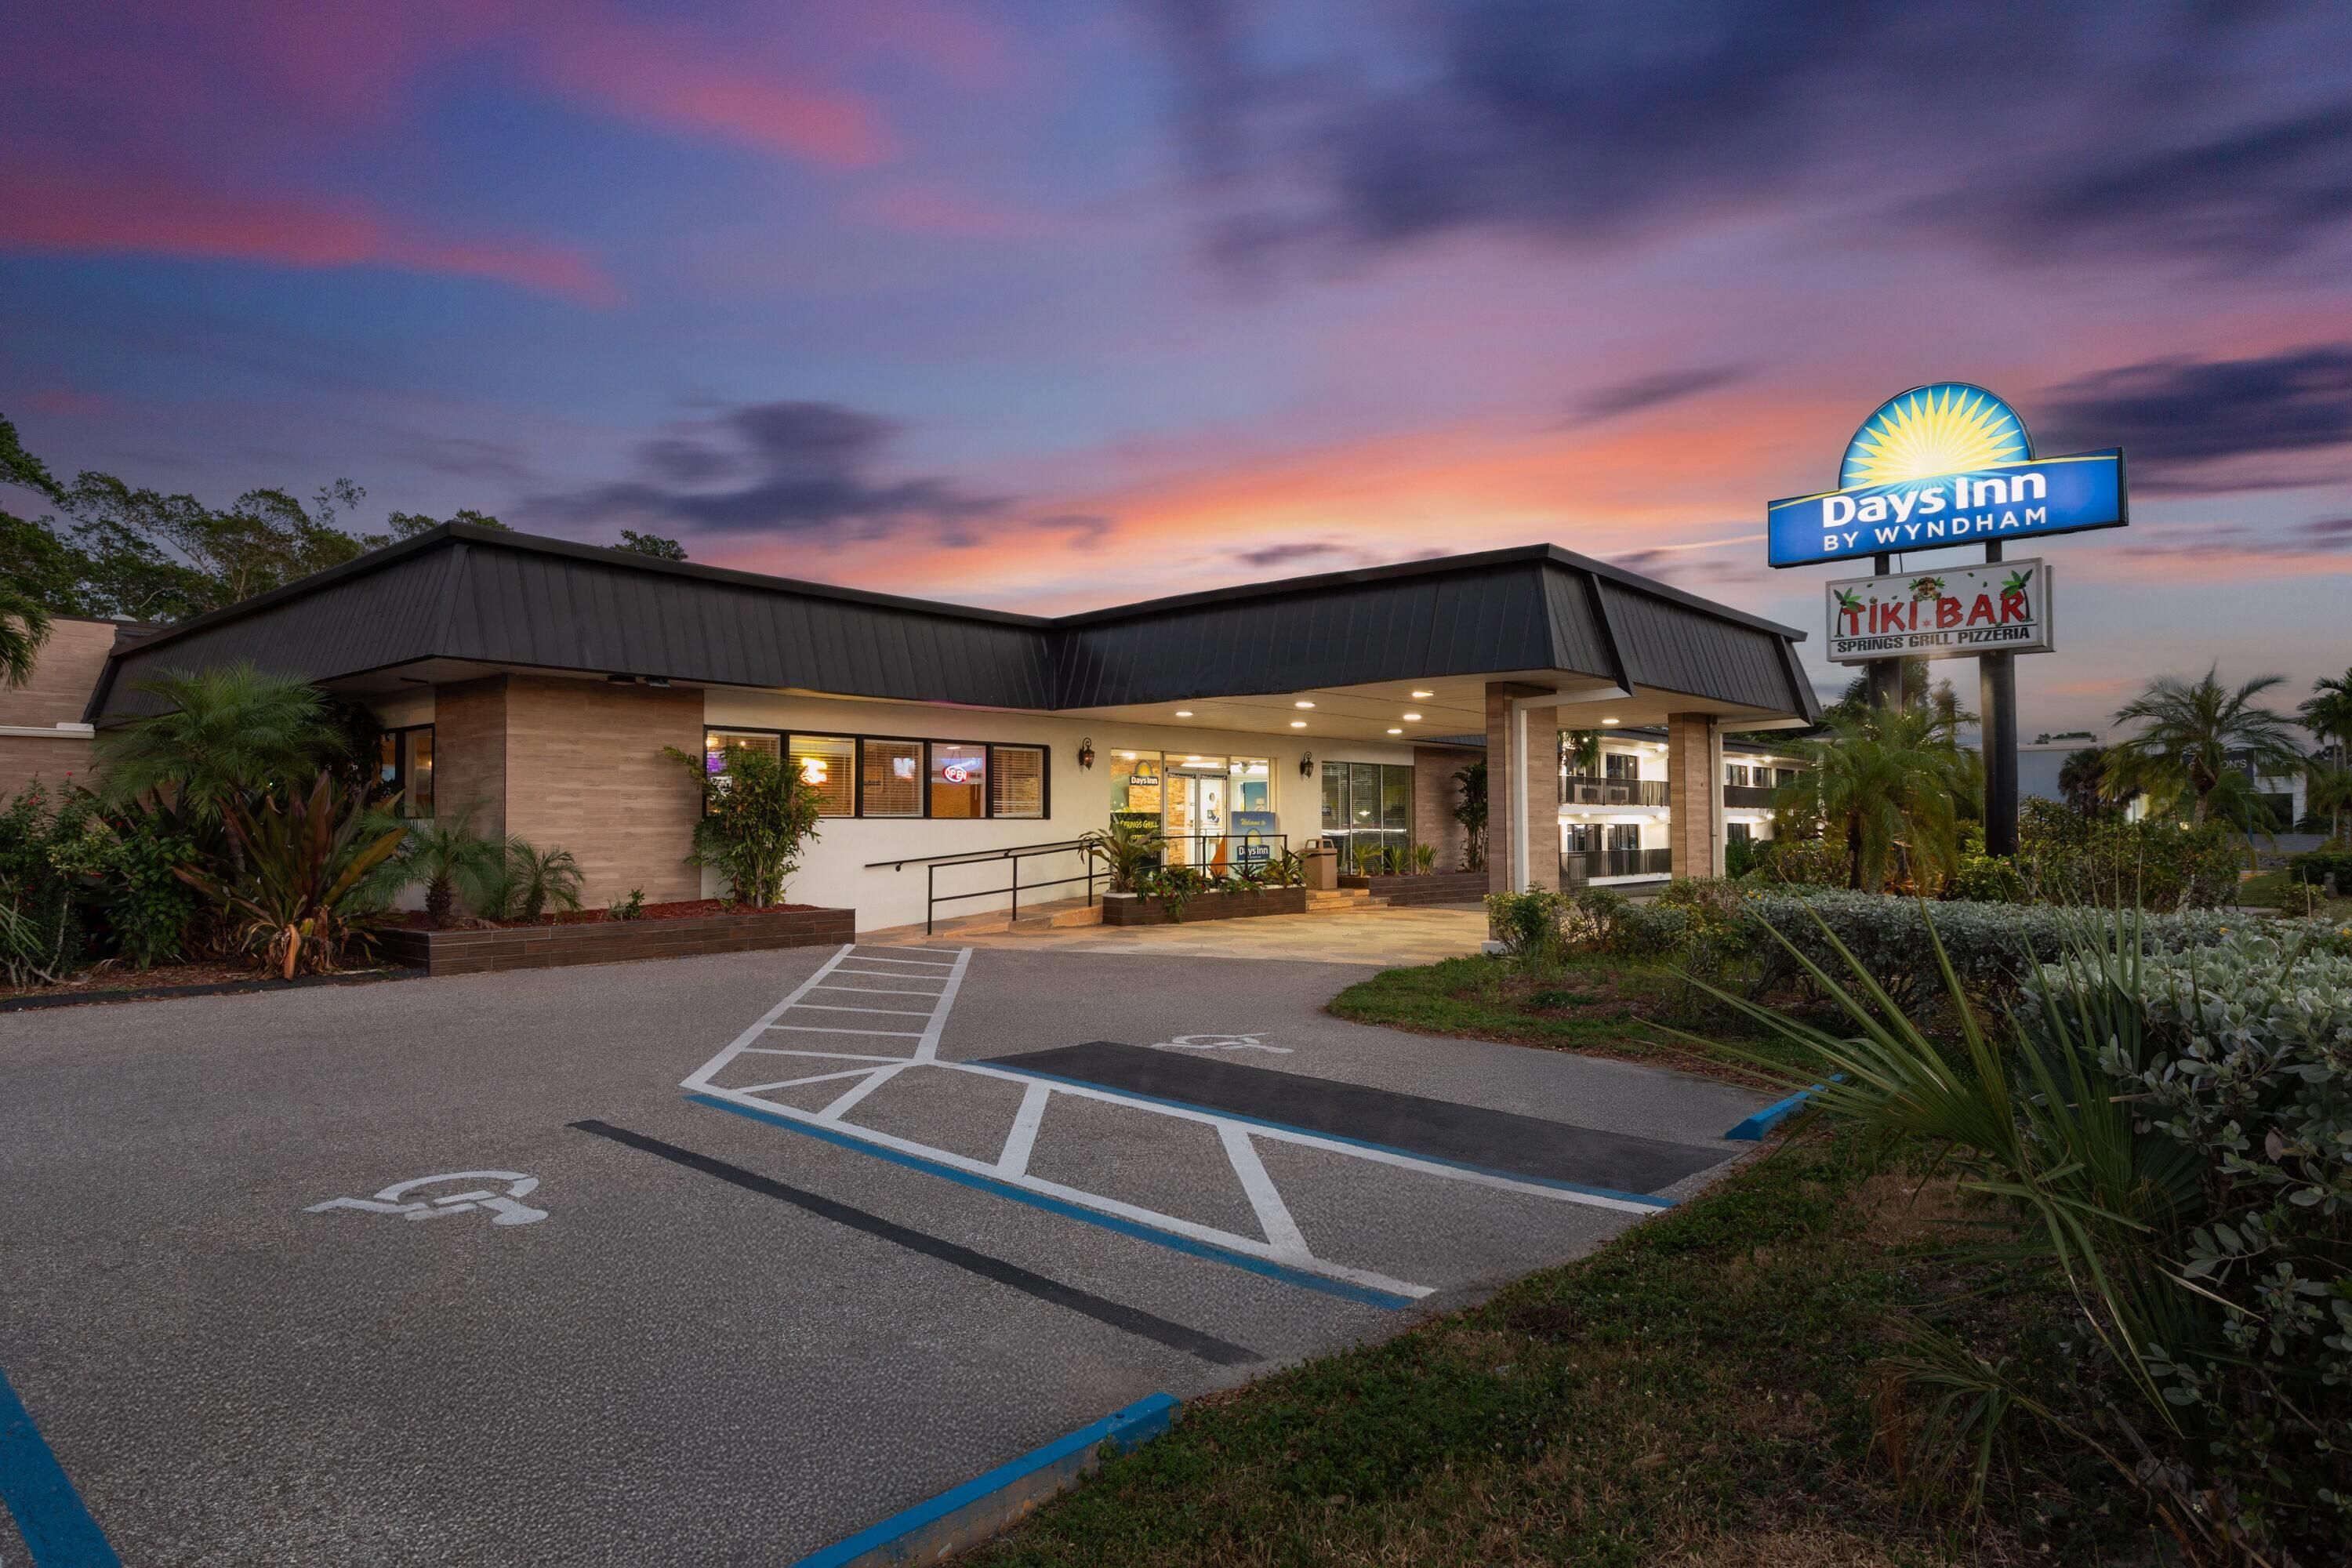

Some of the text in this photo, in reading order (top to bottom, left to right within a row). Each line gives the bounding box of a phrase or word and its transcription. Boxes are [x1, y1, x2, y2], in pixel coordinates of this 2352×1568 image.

[1823, 473, 2046, 528] Days Inn
[1824, 506, 2046, 551] BY WYNDHAM
[1842, 591, 2025, 636] TIKI BAR
[1837, 626, 2030, 653] SPRINGS GRILL PIZZERIA
[1131, 776, 1158, 786] Days Inn
[1239, 847, 1256, 856] Dys
